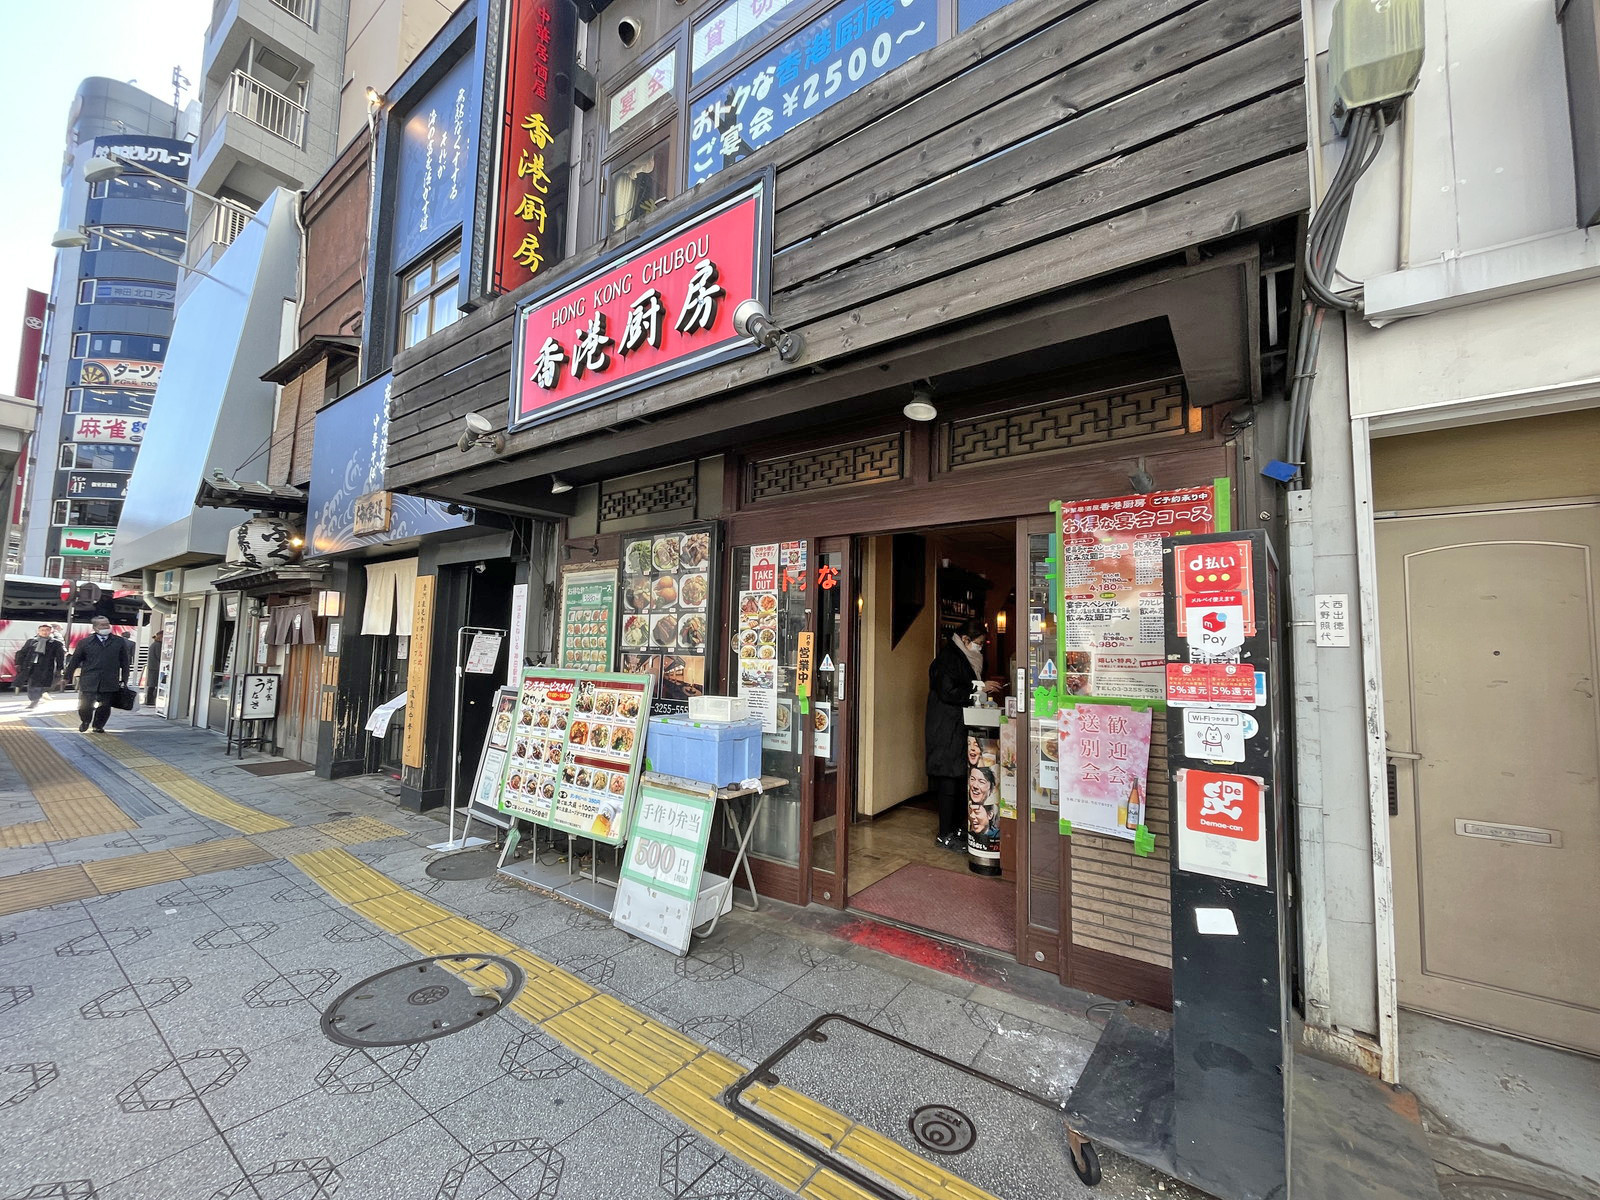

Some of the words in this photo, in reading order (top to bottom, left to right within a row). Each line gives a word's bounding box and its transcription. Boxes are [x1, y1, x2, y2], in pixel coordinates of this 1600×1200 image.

[531, 7, 552, 101] 中華居酒屋
[691, 0, 914, 141] おトクな香港厨房
[693, 106, 775, 173] ご宴会
[512, 113, 555, 274] 香港厨房
[551, 298, 587, 329] HONG
[593, 273, 633, 307] KONG
[642, 233, 710, 285] CHUBOU
[529, 257, 722, 390] 香港厨房
[113, 362, 162, 379] ダーツ
[77, 417, 128, 439] 麻雀
[70, 481, 86, 494] 4F
[1153, 492, 1208, 505] ご予約承り中
[1063, 505, 1213, 534] お得な宴会コース
[1189, 554, 1235, 571] d払い
[753, 569, 774, 580] TAKE
[755, 580, 771, 590] OUT
[1139, 599, 1164, 607] フカヒレ
[1191, 596, 1236, 604] メルペイ使えます
[1066, 613, 1131, 622] 飲み放題コース
[1319, 600, 1331, 641] 大野照代
[1332, 600, 1345, 638] 西出徳一
[1203, 633, 1227, 646] Pay
[798, 647, 811, 684] 営業中
[523, 680, 574, 693] ランチサービスタイム
[1169, 685, 1208, 695] 5%還元
[1211, 686, 1253, 696] 5%還元
[1080, 713, 1100, 782] 送別会
[1107, 715, 1128, 786] 歓迎会
[1224, 784, 1241, 796] De
[642, 803, 701, 834] 手作り弁当
[1200, 818, 1244, 832] Demae-can
